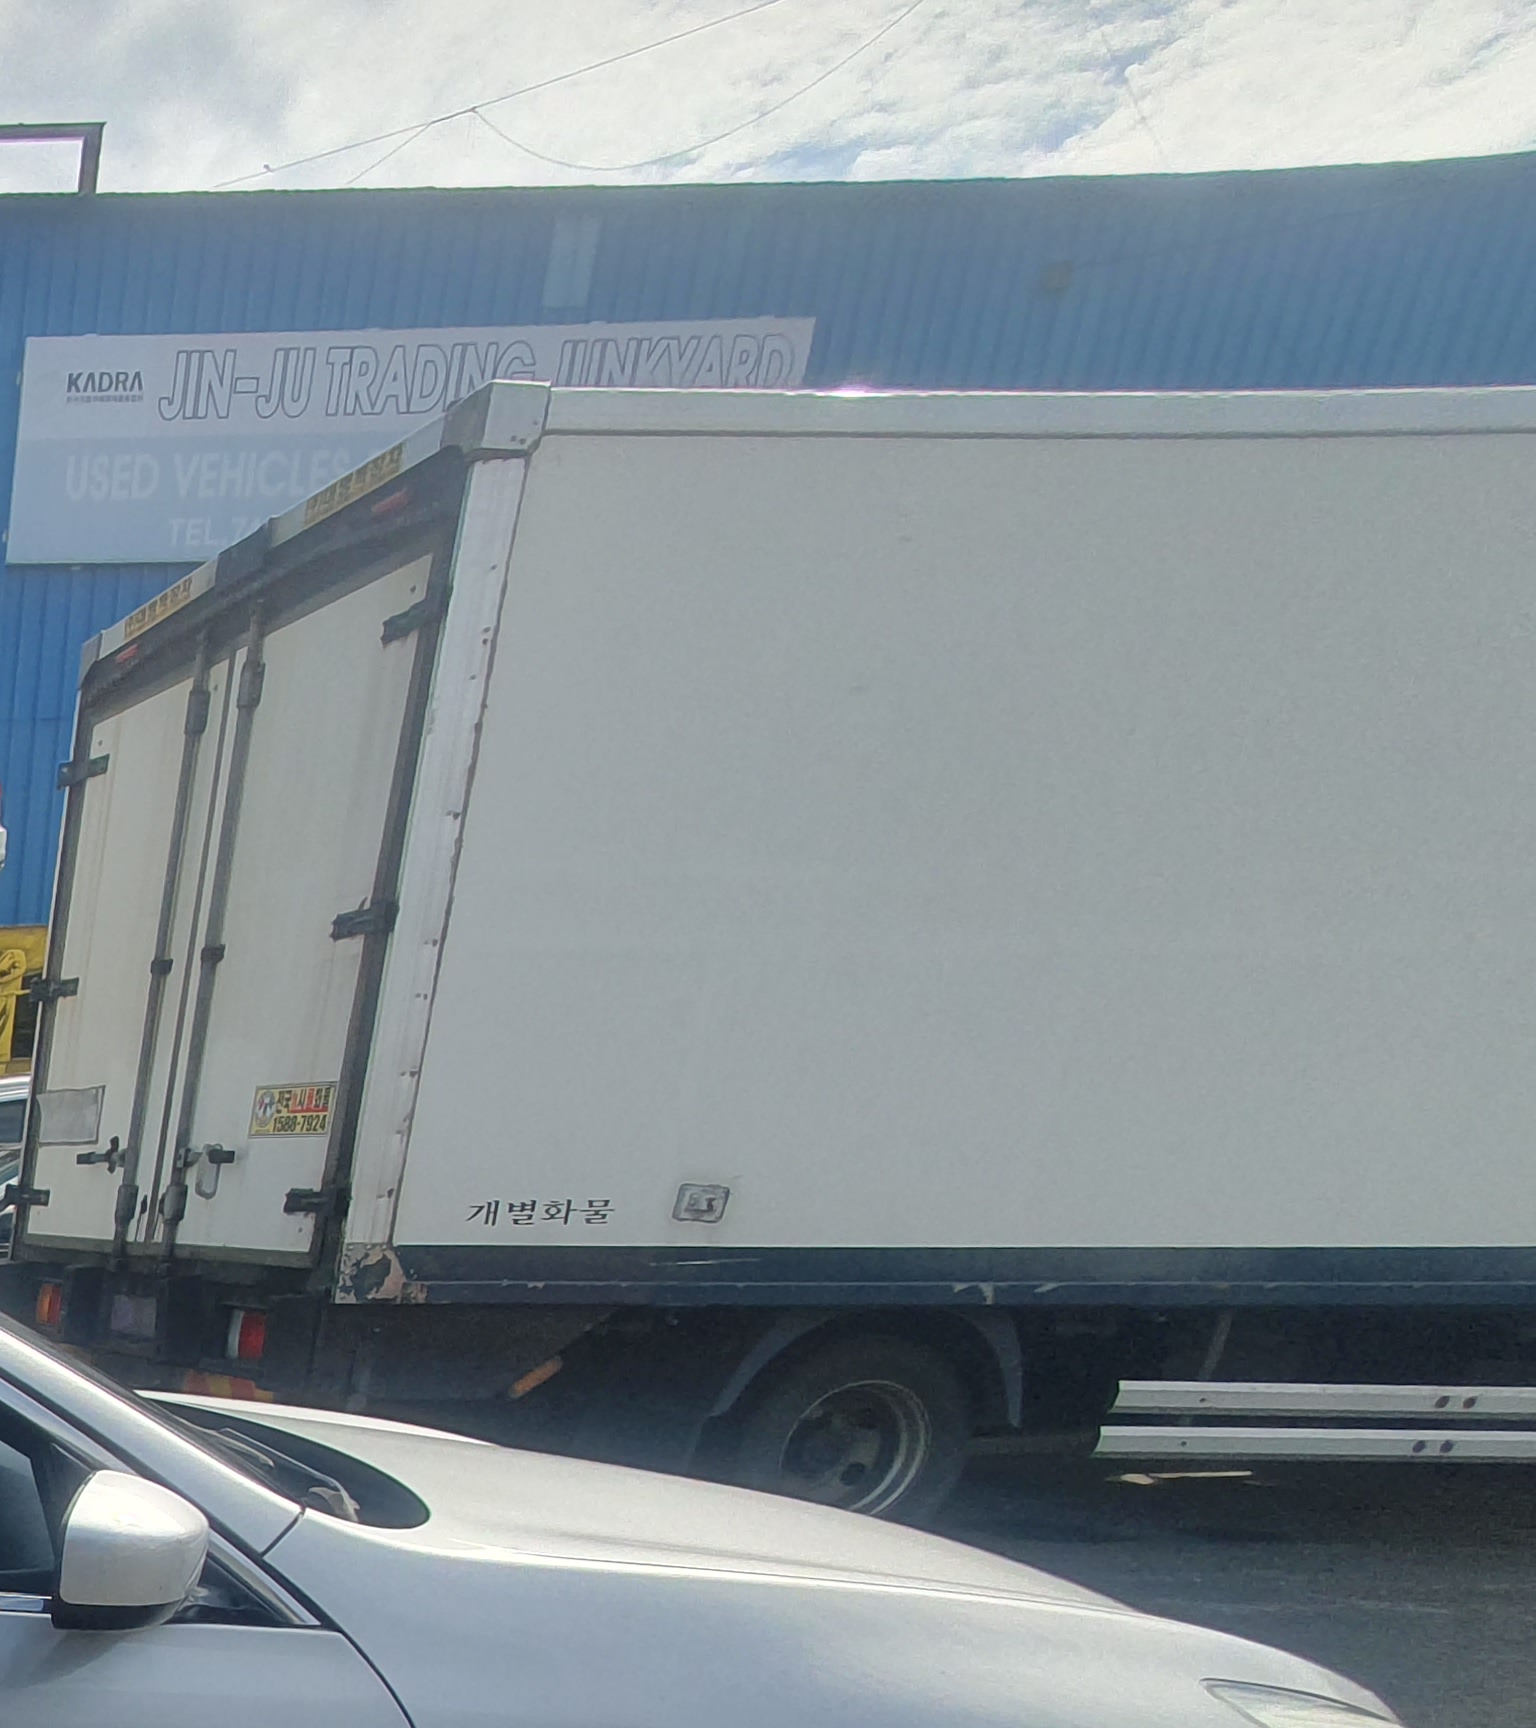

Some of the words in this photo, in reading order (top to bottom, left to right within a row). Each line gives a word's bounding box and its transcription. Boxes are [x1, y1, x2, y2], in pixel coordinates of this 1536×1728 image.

[66, 370, 144, 394] KADRA
[158, 347, 316, 421] JIN-JU
[325, 339, 535, 417] TRADING
[65, 452, 160, 502] USED
[272, 1114, 327, 1133] 1588-7924
[465, 1198, 615, 1226] 개별화물
